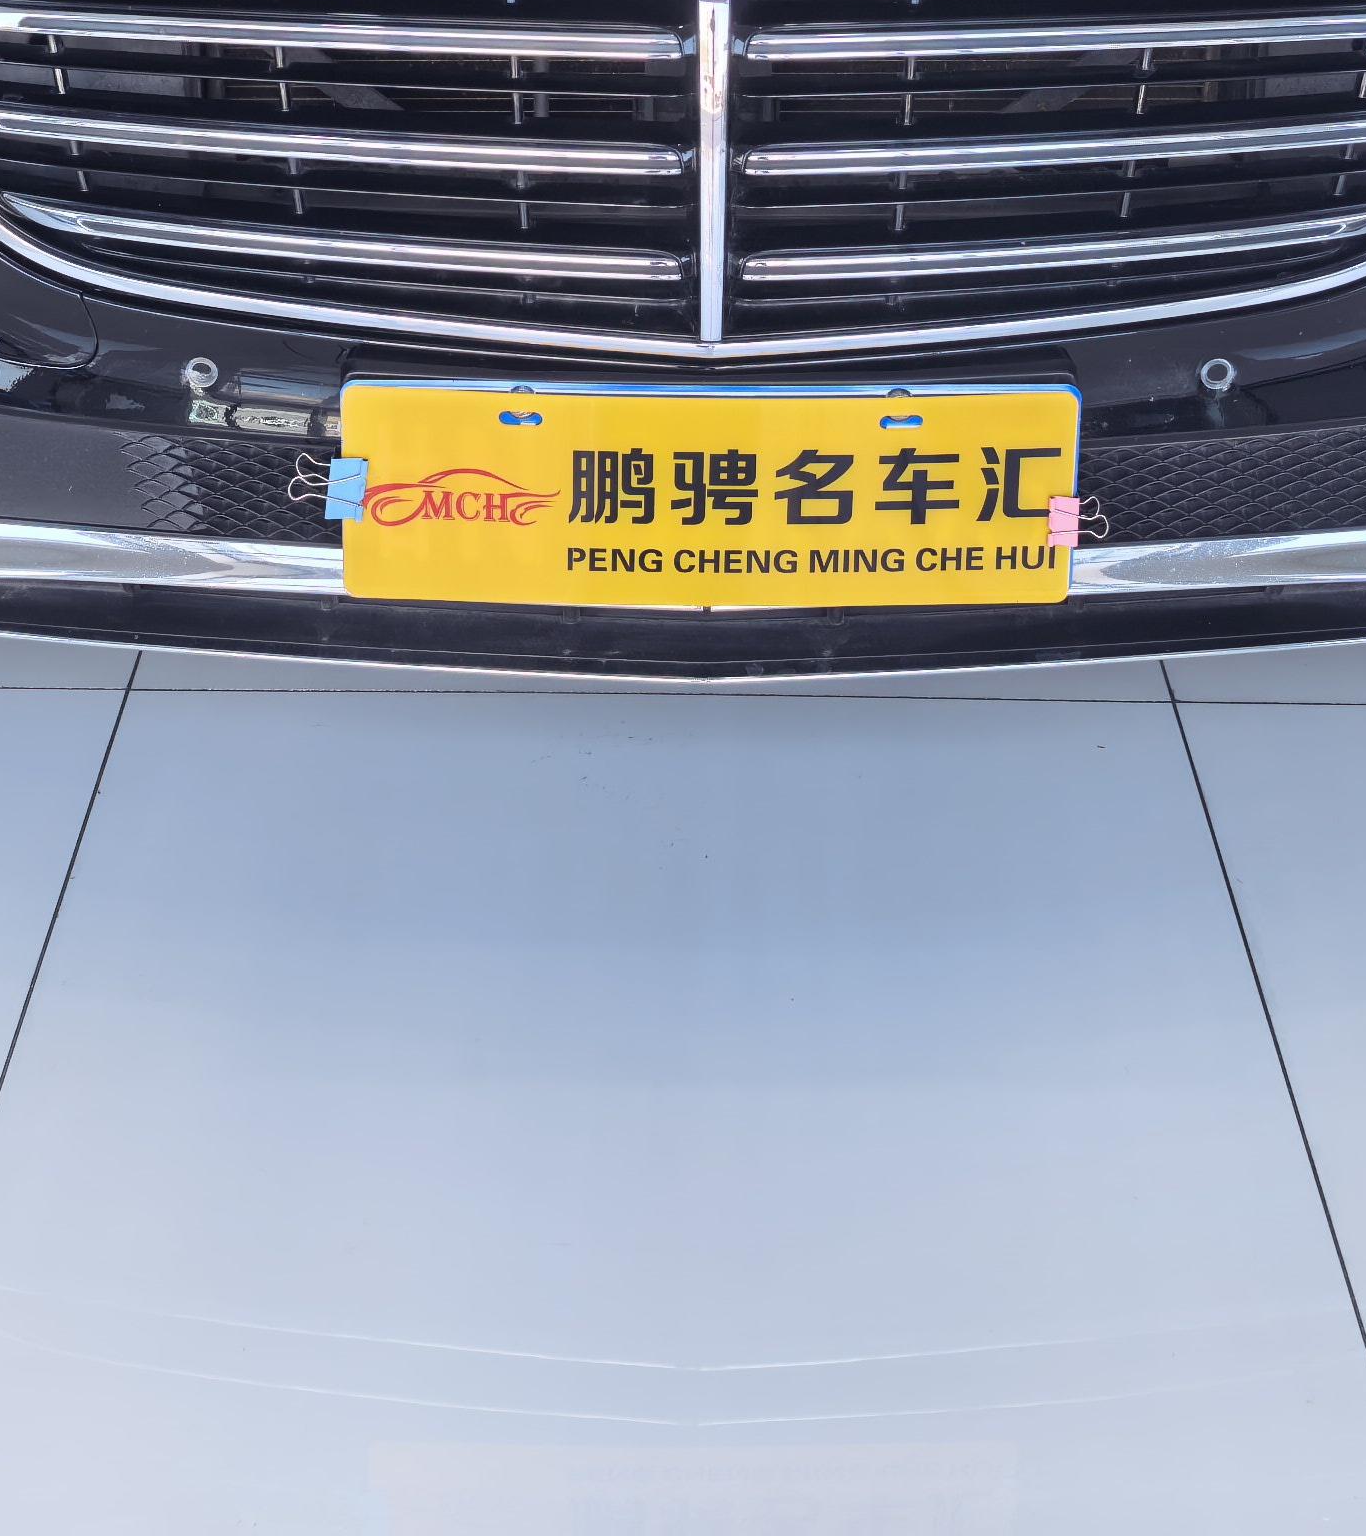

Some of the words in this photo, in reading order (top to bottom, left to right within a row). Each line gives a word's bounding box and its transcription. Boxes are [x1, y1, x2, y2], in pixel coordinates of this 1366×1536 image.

[568, 446, 1062, 526] 鹏骋名车汇
[566, 547, 663, 573] PENG
[673, 549, 798, 574] CHENG
[809, 548, 905, 573] MING
[915, 546, 984, 572] CHE
[995, 545, 1056, 570] HUI
